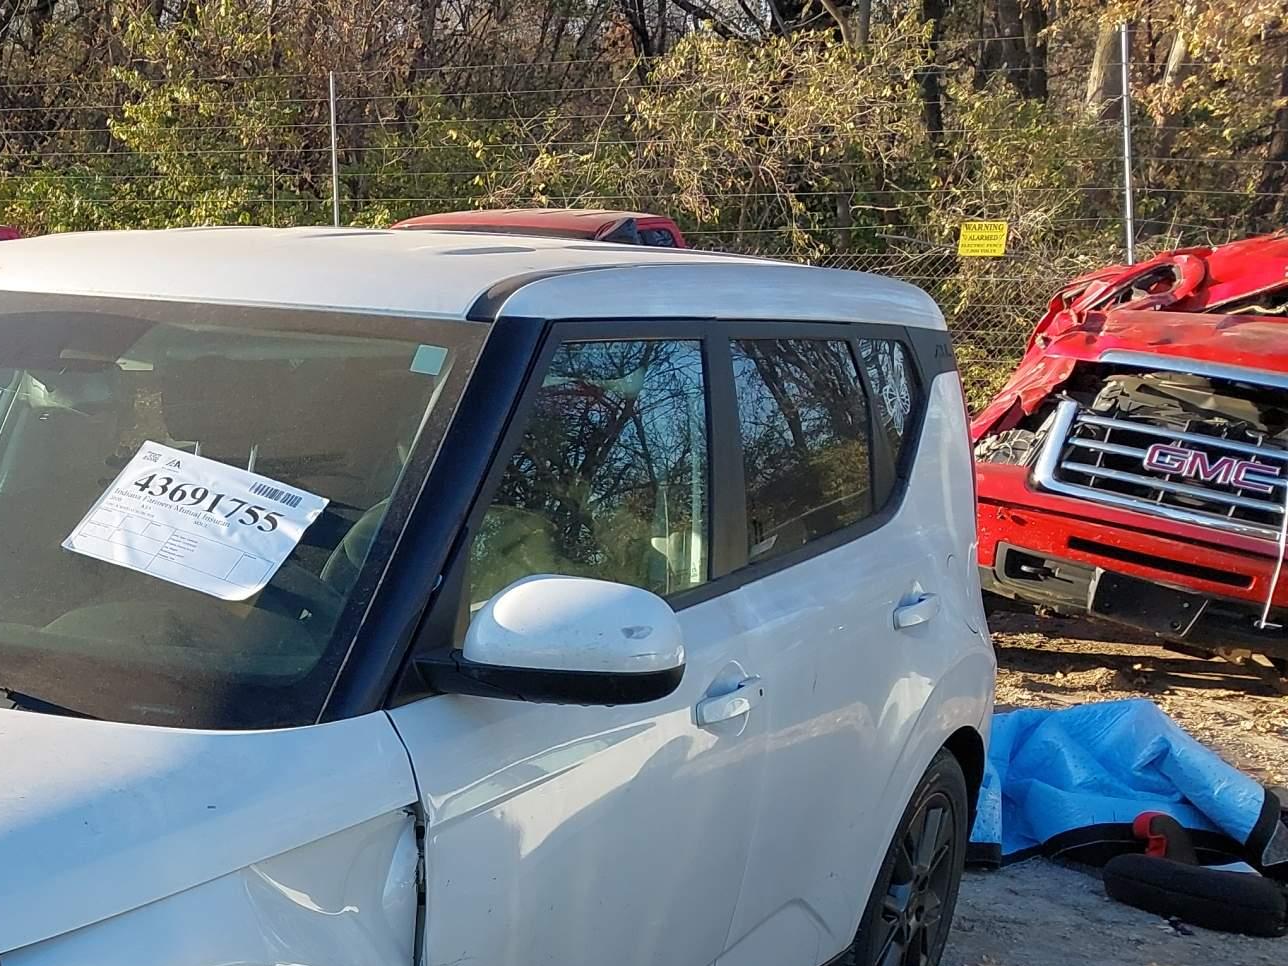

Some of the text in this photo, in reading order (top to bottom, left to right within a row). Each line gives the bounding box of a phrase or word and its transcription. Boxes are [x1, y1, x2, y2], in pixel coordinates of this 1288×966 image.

[964, 223, 1004, 231] WARNING
[1143, 442, 1281, 495] GMC
[114, 487, 142, 500] Indiana
[173, 503, 201, 520] Mutual
[133, 472, 286, 533] 43691755
